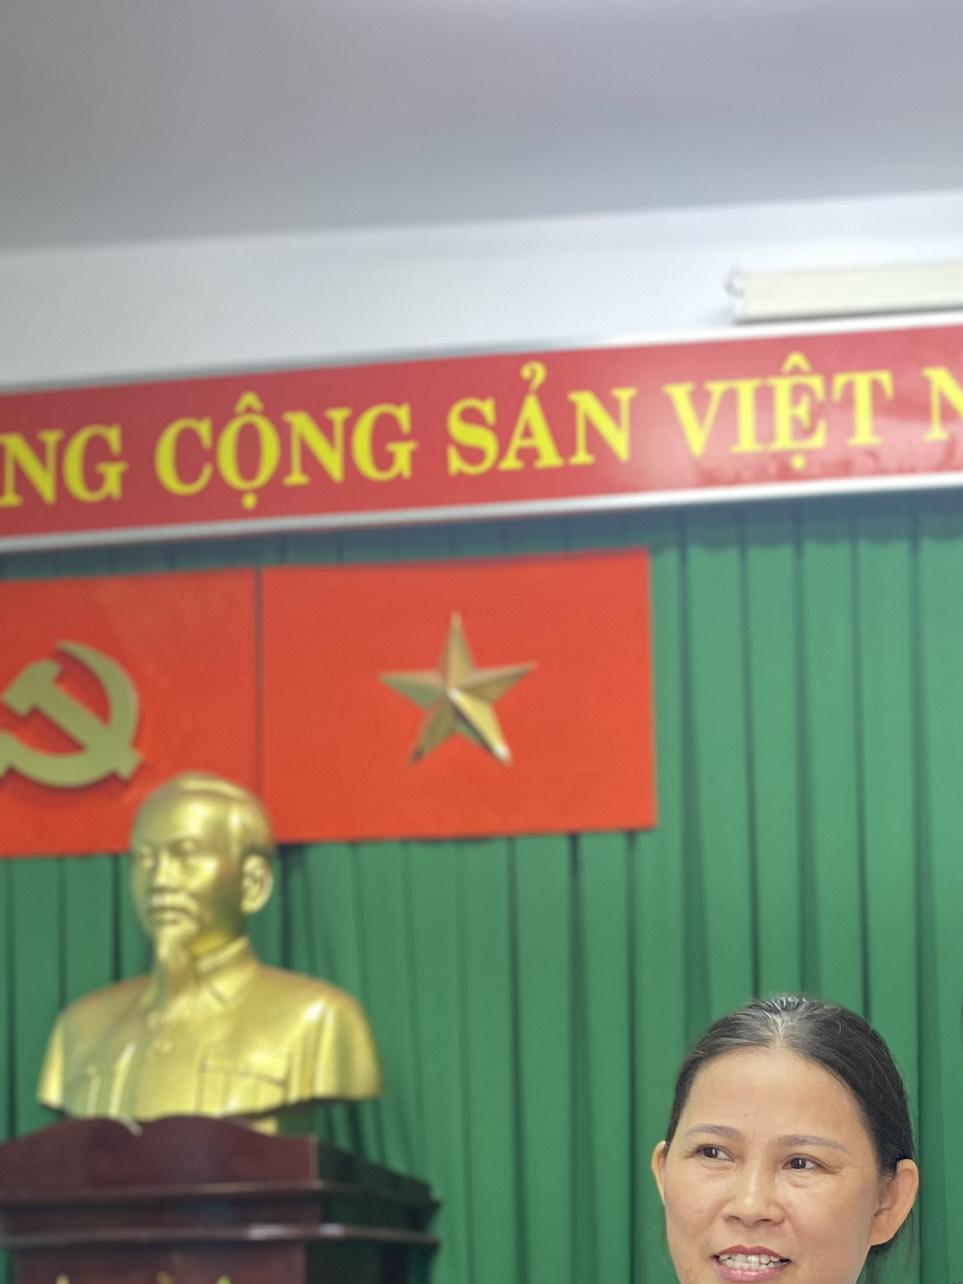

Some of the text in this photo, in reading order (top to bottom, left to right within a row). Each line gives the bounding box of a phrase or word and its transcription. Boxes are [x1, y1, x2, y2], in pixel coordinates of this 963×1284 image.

[156, 392, 417, 509] CỘNG
[447, 362, 635, 475] SẢN
[664, 352, 893, 470] VIỆT
